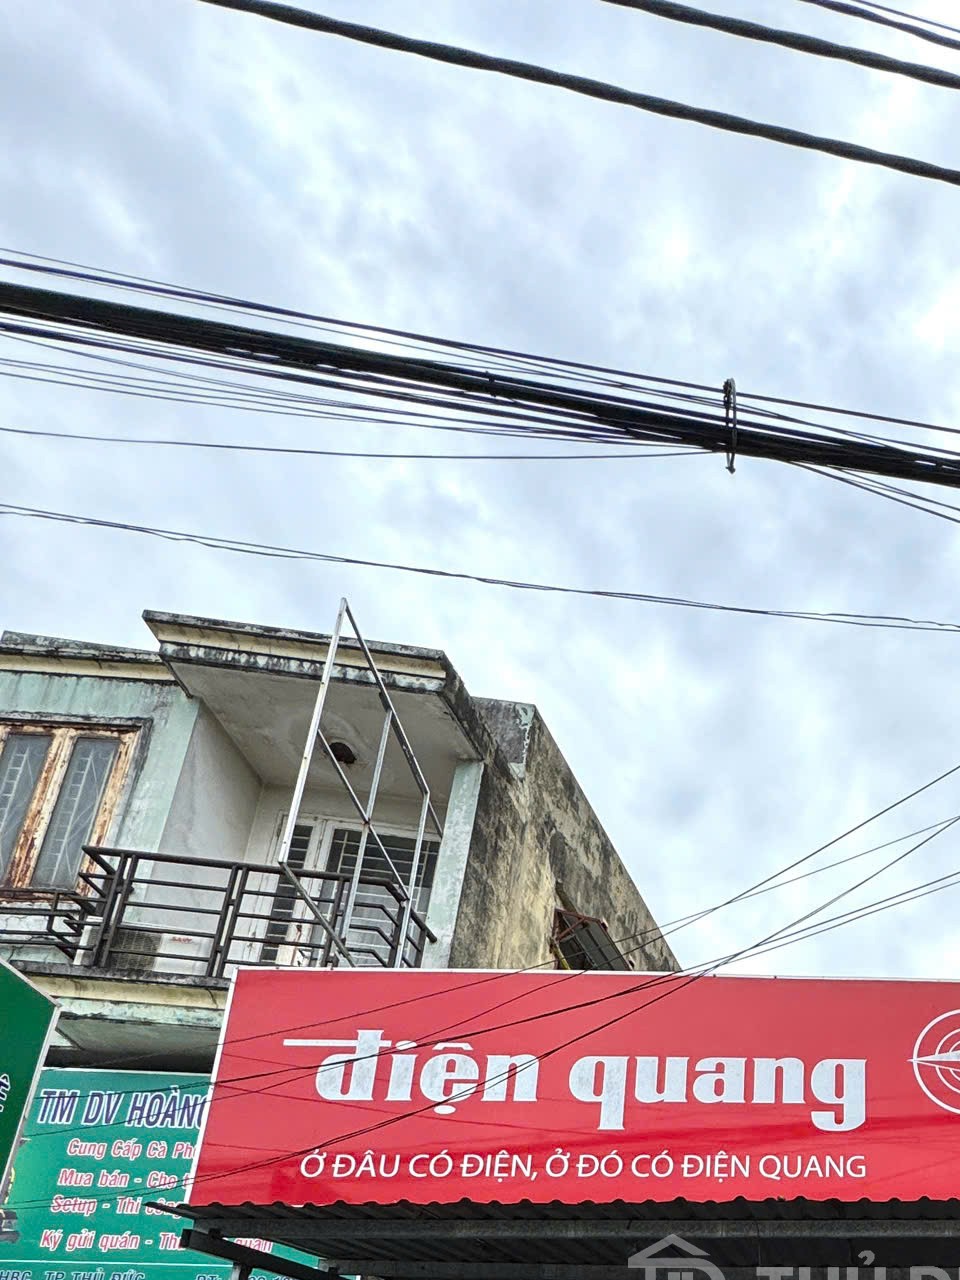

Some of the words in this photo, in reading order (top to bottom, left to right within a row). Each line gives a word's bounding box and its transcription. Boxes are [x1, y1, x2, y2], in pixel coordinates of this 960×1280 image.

[283, 1029, 539, 1114] điện
[569, 1055, 867, 1131] quang
[38, 1089, 80, 1125] TM
[81, 1090, 124, 1126] DV
[67, 1138, 106, 1158] Cung
[111, 1138, 142, 1160] Cấp
[147, 1141, 168, 1158] Cà
[300, 1149, 326, 1178] Ở
[332, 1151, 400, 1178] ĐÂU
[409, 1150, 453, 1178] CÓ
[460, 1151, 538, 1182] ĐIỆN,
[545, 1148, 571, 1178] Ở
[576, 1150, 623, 1178] ĐÓ
[631, 1150, 674, 1178] CÓ
[681, 1151, 750, 1183] ĐIỆN
[758, 1155, 867, 1180] QUANG
[57, 1168, 93, 1188] Mua
[98, 1170, 129, 1188] bán
[51, 1195, 97, 1216] Setup
[116, 1196, 142, 1214] Thi
[40, 1229, 63, 1251] Ký
[66, 1228, 96, 1251] gửi
[99, 1231, 140, 1252] quán
